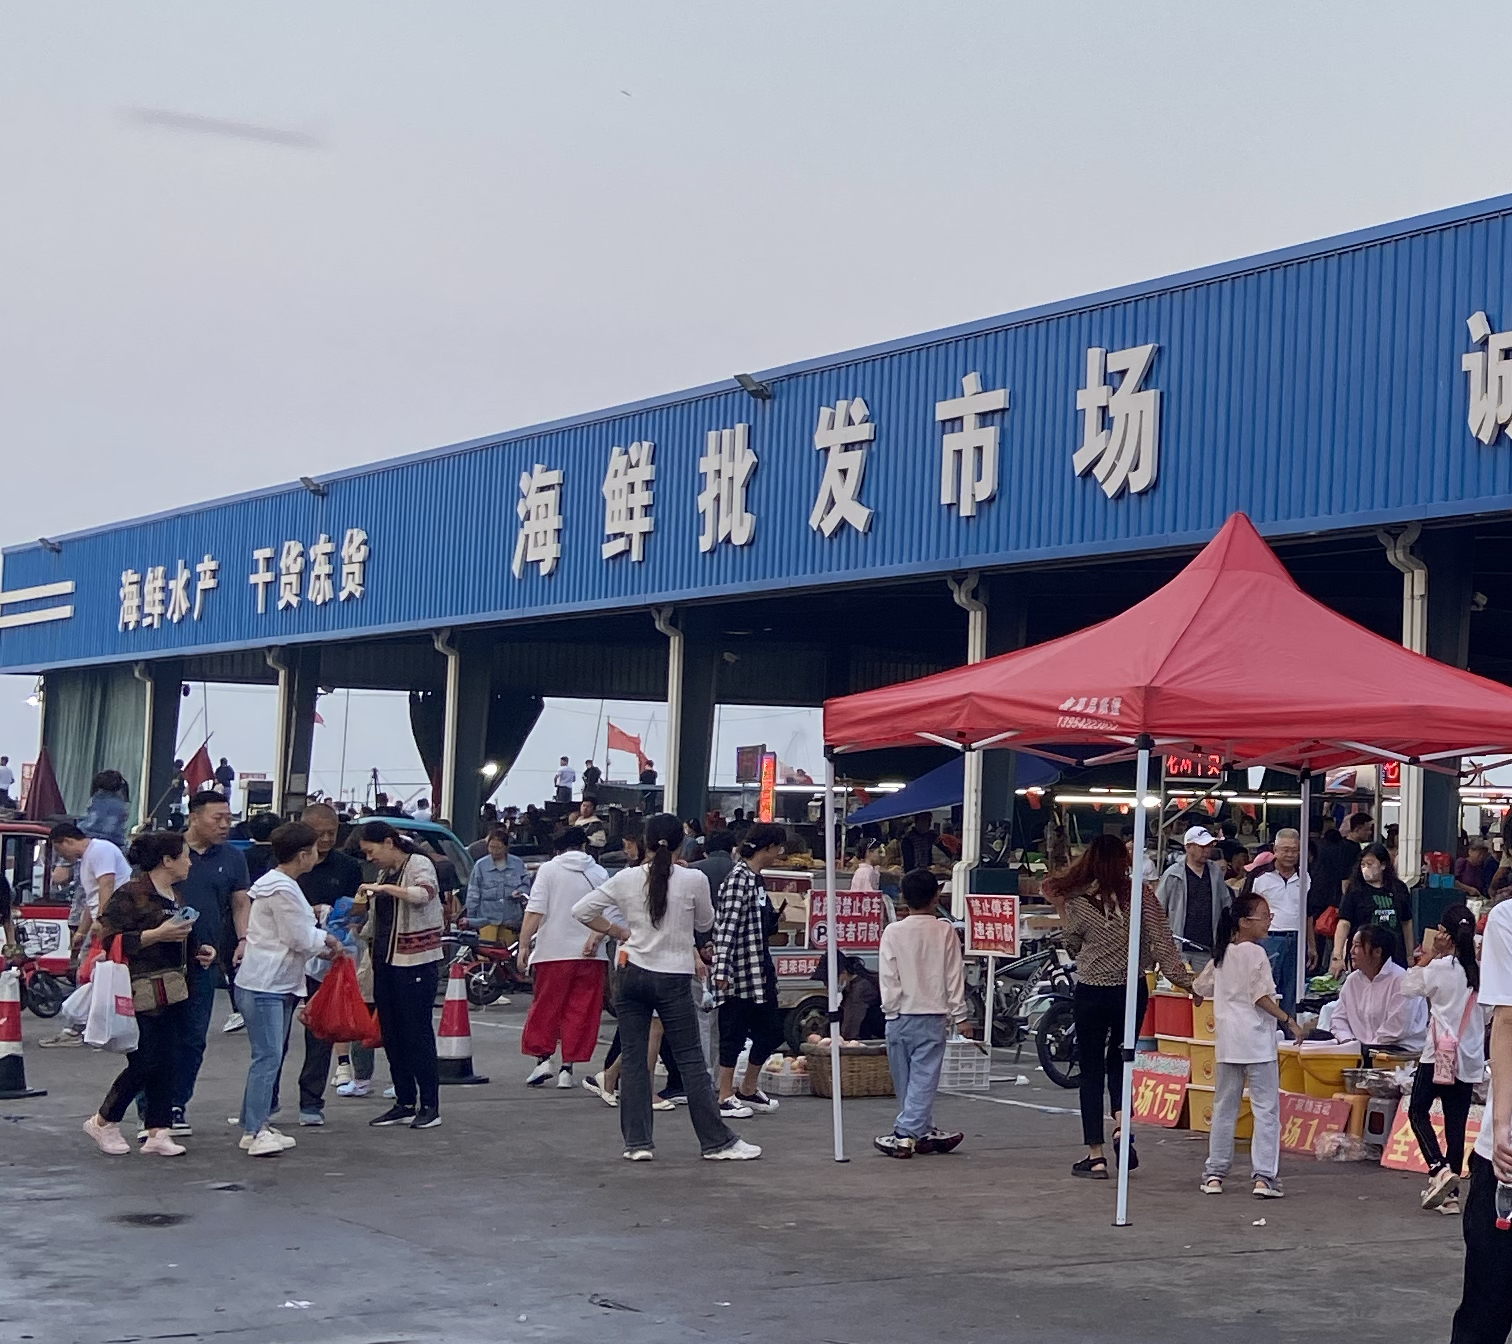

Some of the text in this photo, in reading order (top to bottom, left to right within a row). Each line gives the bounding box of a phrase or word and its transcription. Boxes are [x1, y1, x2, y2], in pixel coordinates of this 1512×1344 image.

[512, 343, 1161, 579] 海鲜批发市场
[118, 528, 369, 632] 海鲜水产 干货冻货
[970, 899, 1013, 918] 禁止停车
[1132, 1077, 1181, 1120] 场1元
